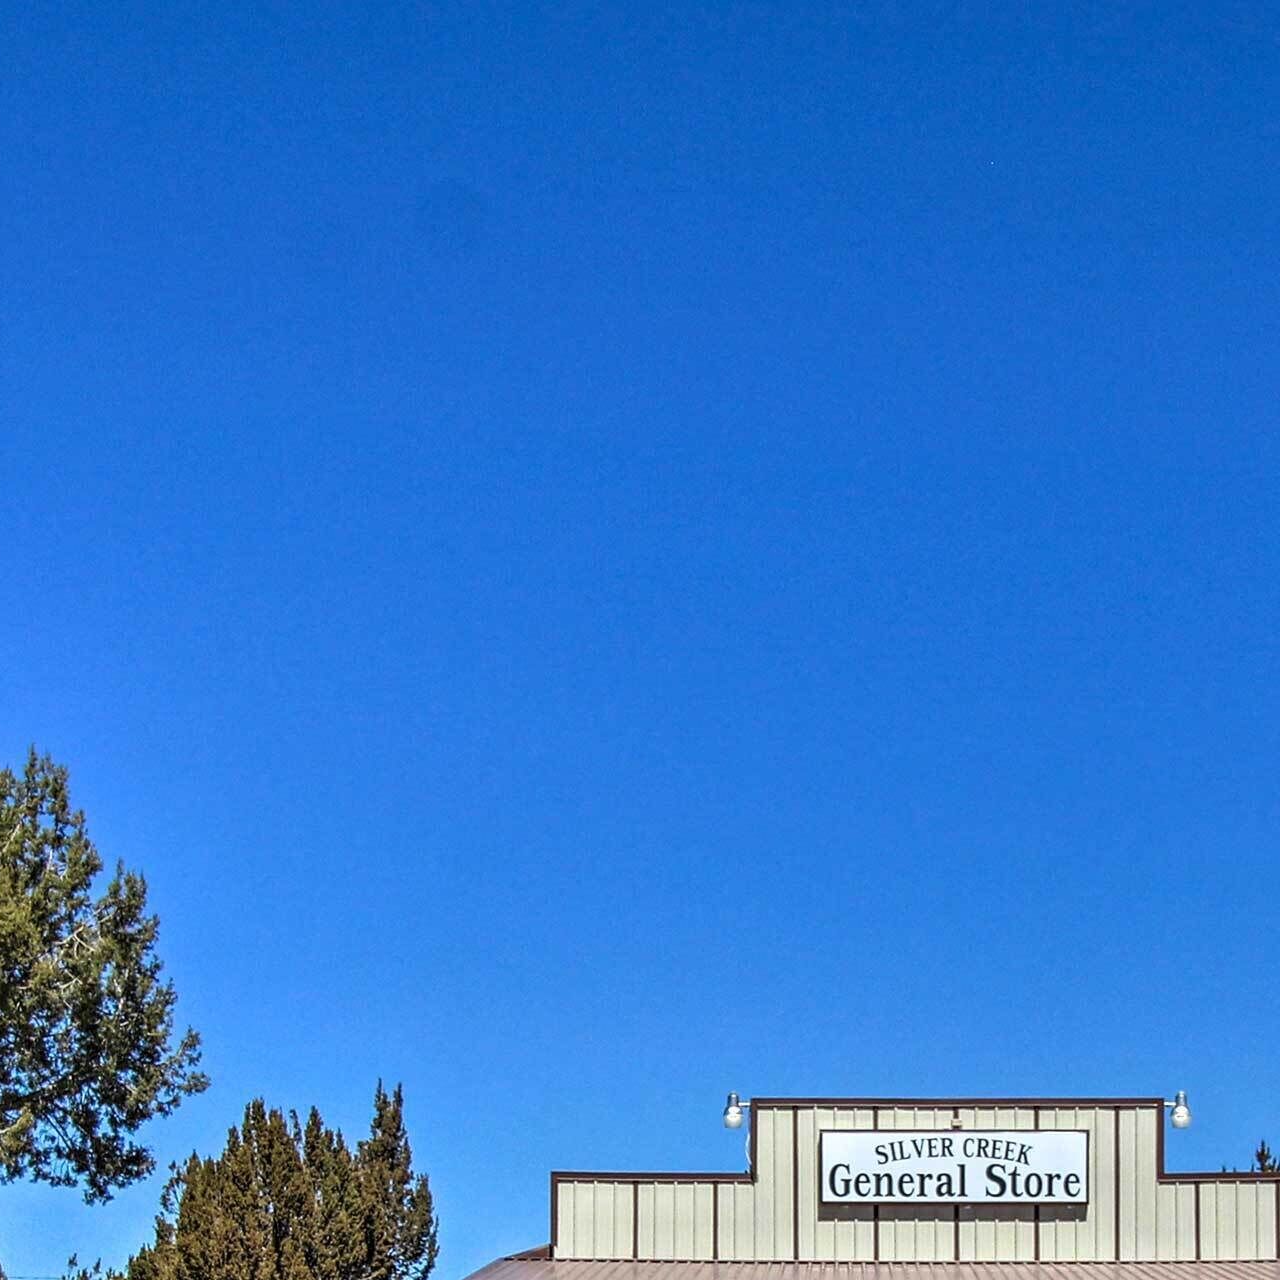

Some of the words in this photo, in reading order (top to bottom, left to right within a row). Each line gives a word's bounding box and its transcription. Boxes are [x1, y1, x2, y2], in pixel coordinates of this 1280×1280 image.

[875, 1137, 954, 1165] SILVER
[963, 1137, 1034, 1166] CREEK
[828, 1163, 968, 1198] General
[984, 1163, 1081, 1198] Store
